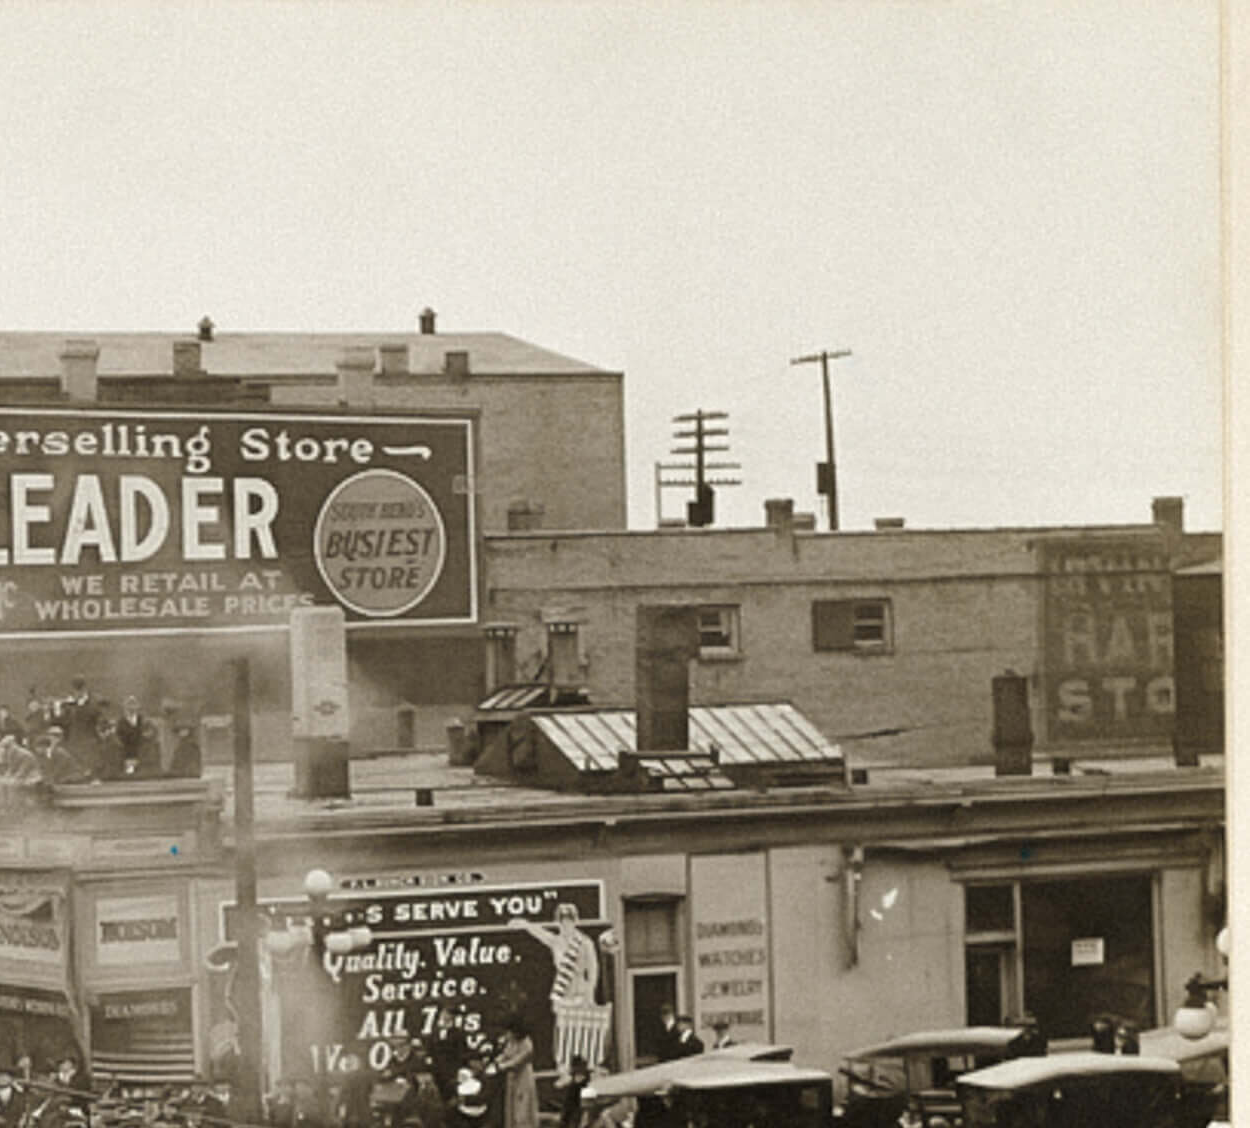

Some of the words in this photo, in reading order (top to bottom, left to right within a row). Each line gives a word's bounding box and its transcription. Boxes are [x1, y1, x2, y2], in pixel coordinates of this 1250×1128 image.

[240, 428, 374, 463] Store
[325, 527, 435, 561] BUSIEST
[61, 574, 103, 596] WE
[119, 572, 226, 594] RETAIL
[238, 569, 283, 591] AT
[340, 566, 422, 591] STORE
[34, 596, 211, 621] WHOLESALE
[393, 900, 479, 922] SERVE
[698, 948, 766, 968] WATCHES
[700, 979, 763, 1000] JEWELRY
[357, 1010, 409, 1040] All
